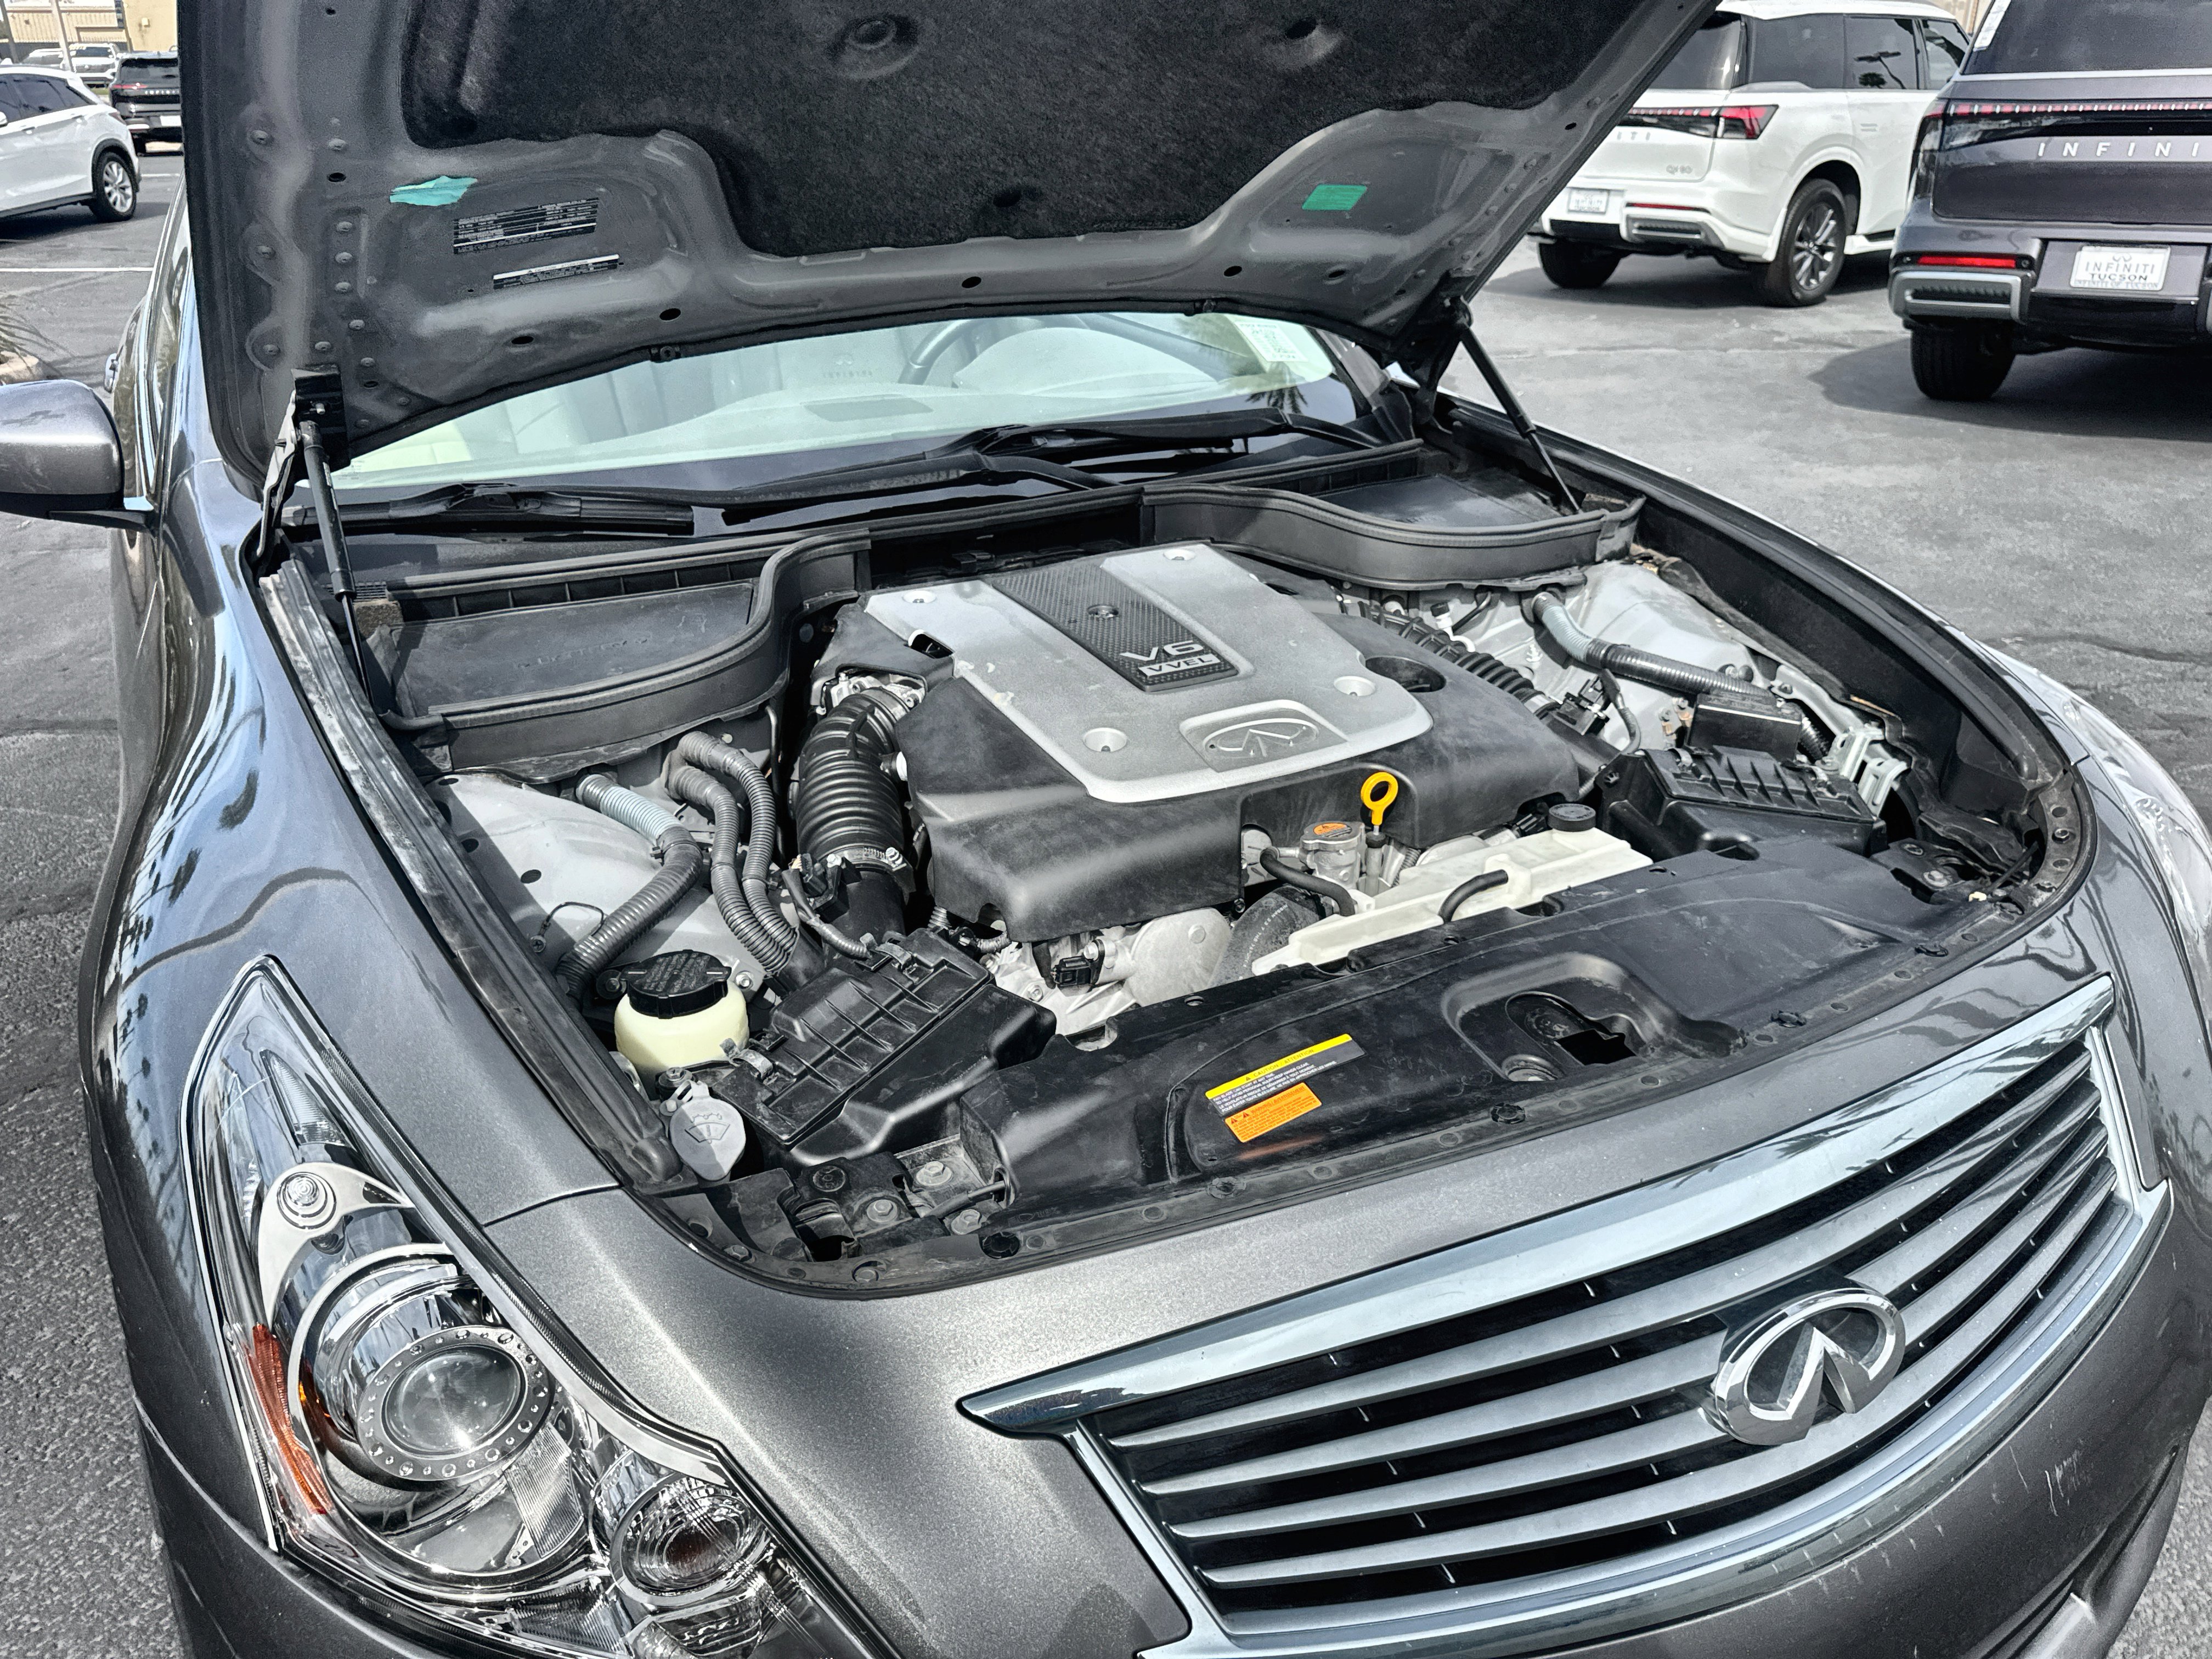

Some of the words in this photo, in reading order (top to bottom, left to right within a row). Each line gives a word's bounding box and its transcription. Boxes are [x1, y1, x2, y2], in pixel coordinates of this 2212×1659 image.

[2085, 261, 2155, 274] INFINITI
[2089, 273, 2148, 281] TUCSON
[1120, 640, 1203, 661] V6
[1147, 657, 1212, 672] VVEL
[1252, 1064, 1279, 1077] CAUTION
[1283, 1049, 1314, 1064] ATTENTION
